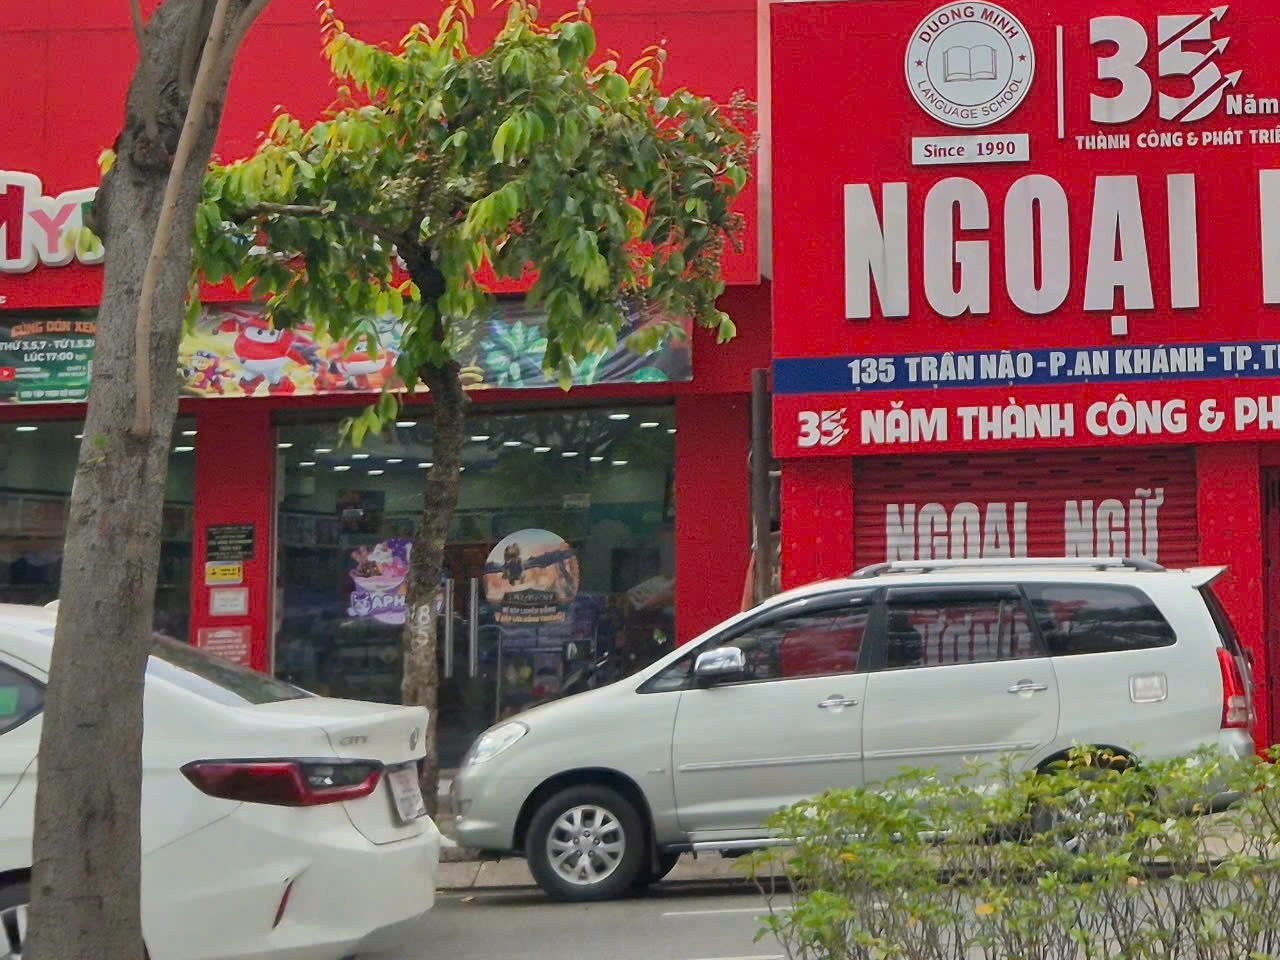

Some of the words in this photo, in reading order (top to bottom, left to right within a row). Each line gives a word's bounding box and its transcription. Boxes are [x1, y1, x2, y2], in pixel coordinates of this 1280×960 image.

[919, 6, 975, 45] DUONG
[980, 7, 1020, 40] MINH
[1089, 15, 1224, 124] 35
[917, 79, 978, 119] LANGUAGE
[981, 77, 1024, 117] SCHOOL
[1226, 93, 1279, 115] Năm
[923, 143, 965, 158] Since
[976, 141, 1016, 156] 1990
[1075, 130, 1130, 150] THÀNH
[1136, 129, 1183, 148] CÔNG
[1186, 132, 1199, 147] &
[1202, 127, 1244, 146] PHÁT
[843, 173, 1200, 336] NGOẠI
[847, 357, 896, 385] 135
[905, 351, 975, 382] TRẦN
[797, 407, 849, 448] 35
[860, 400, 948, 444] NĂM
[956, 397, 1075, 442] THÀNH
[1085, 393, 1188, 436] CÔNG
[1199, 398, 1225, 433] &
